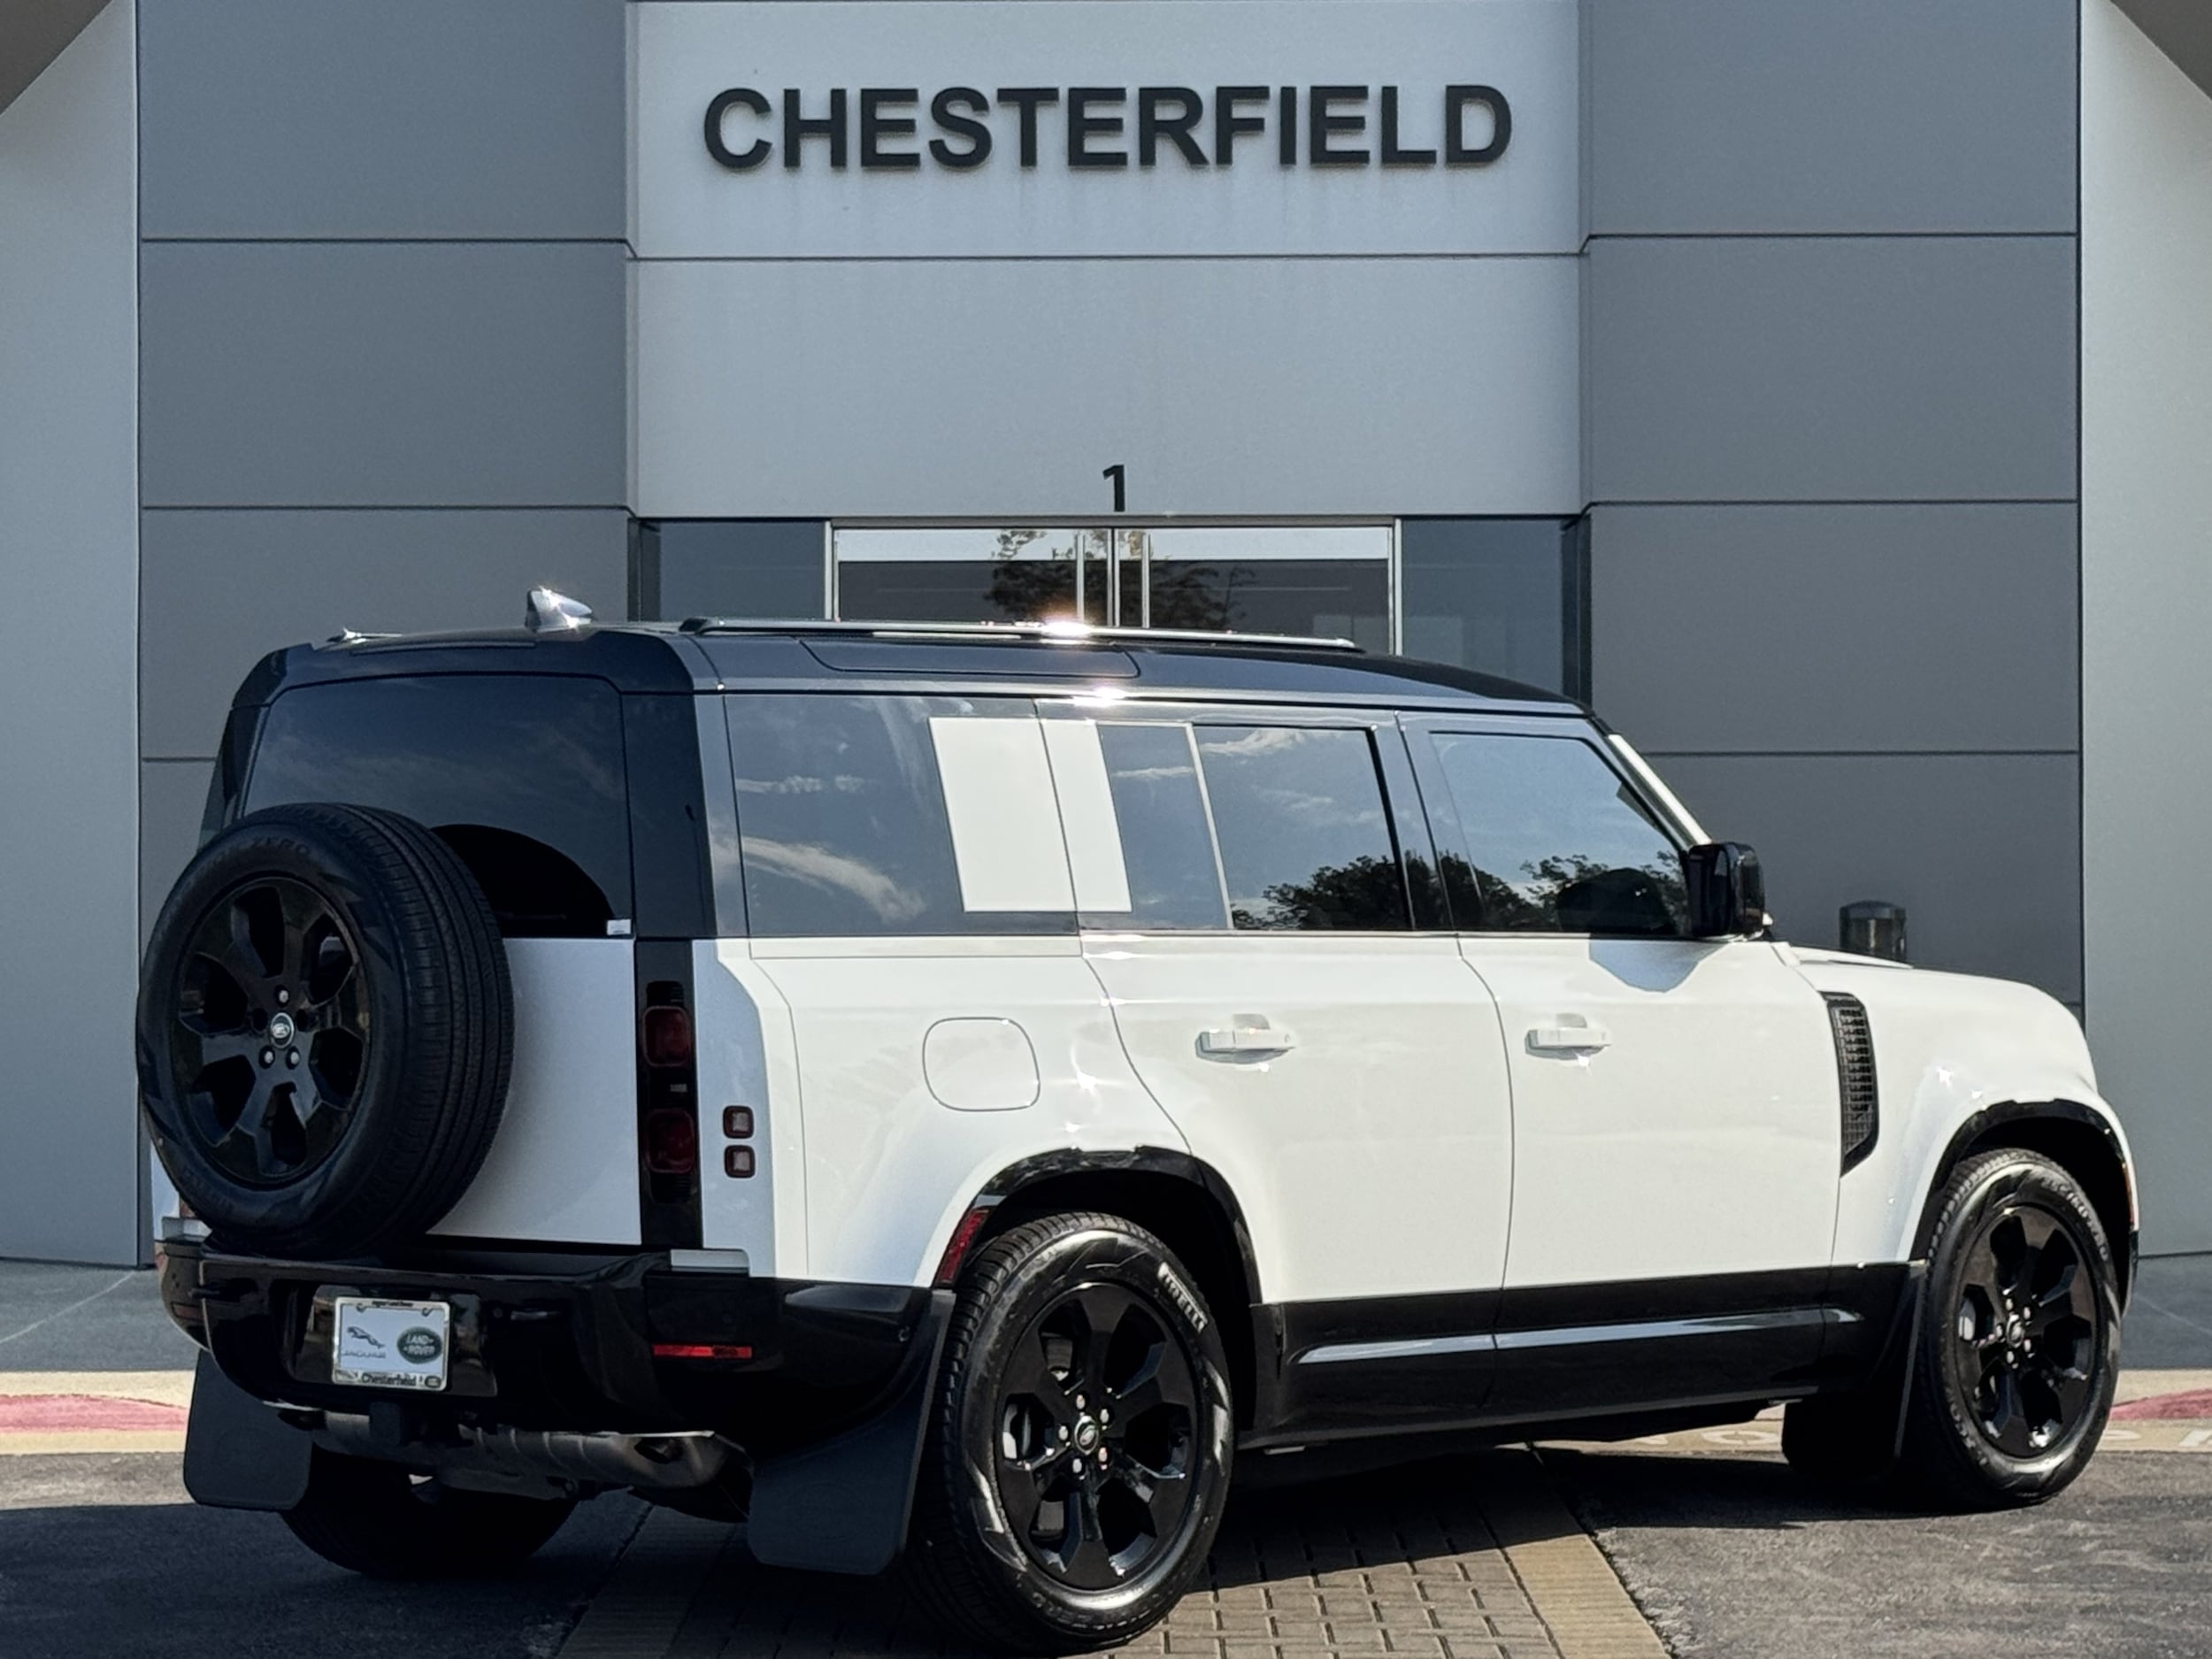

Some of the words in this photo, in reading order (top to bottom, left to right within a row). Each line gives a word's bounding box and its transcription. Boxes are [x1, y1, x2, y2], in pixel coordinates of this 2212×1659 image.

[704, 85, 1511, 173] CHESTERFIELD
[1102, 465, 1125, 512] 1
[1157, 1262, 1209, 1333] PIRELLI
[406, 1333, 431, 1345] LAND
[408, 1345, 435, 1356] ROVER
[342, 1349, 386, 1359] JAGUAR
